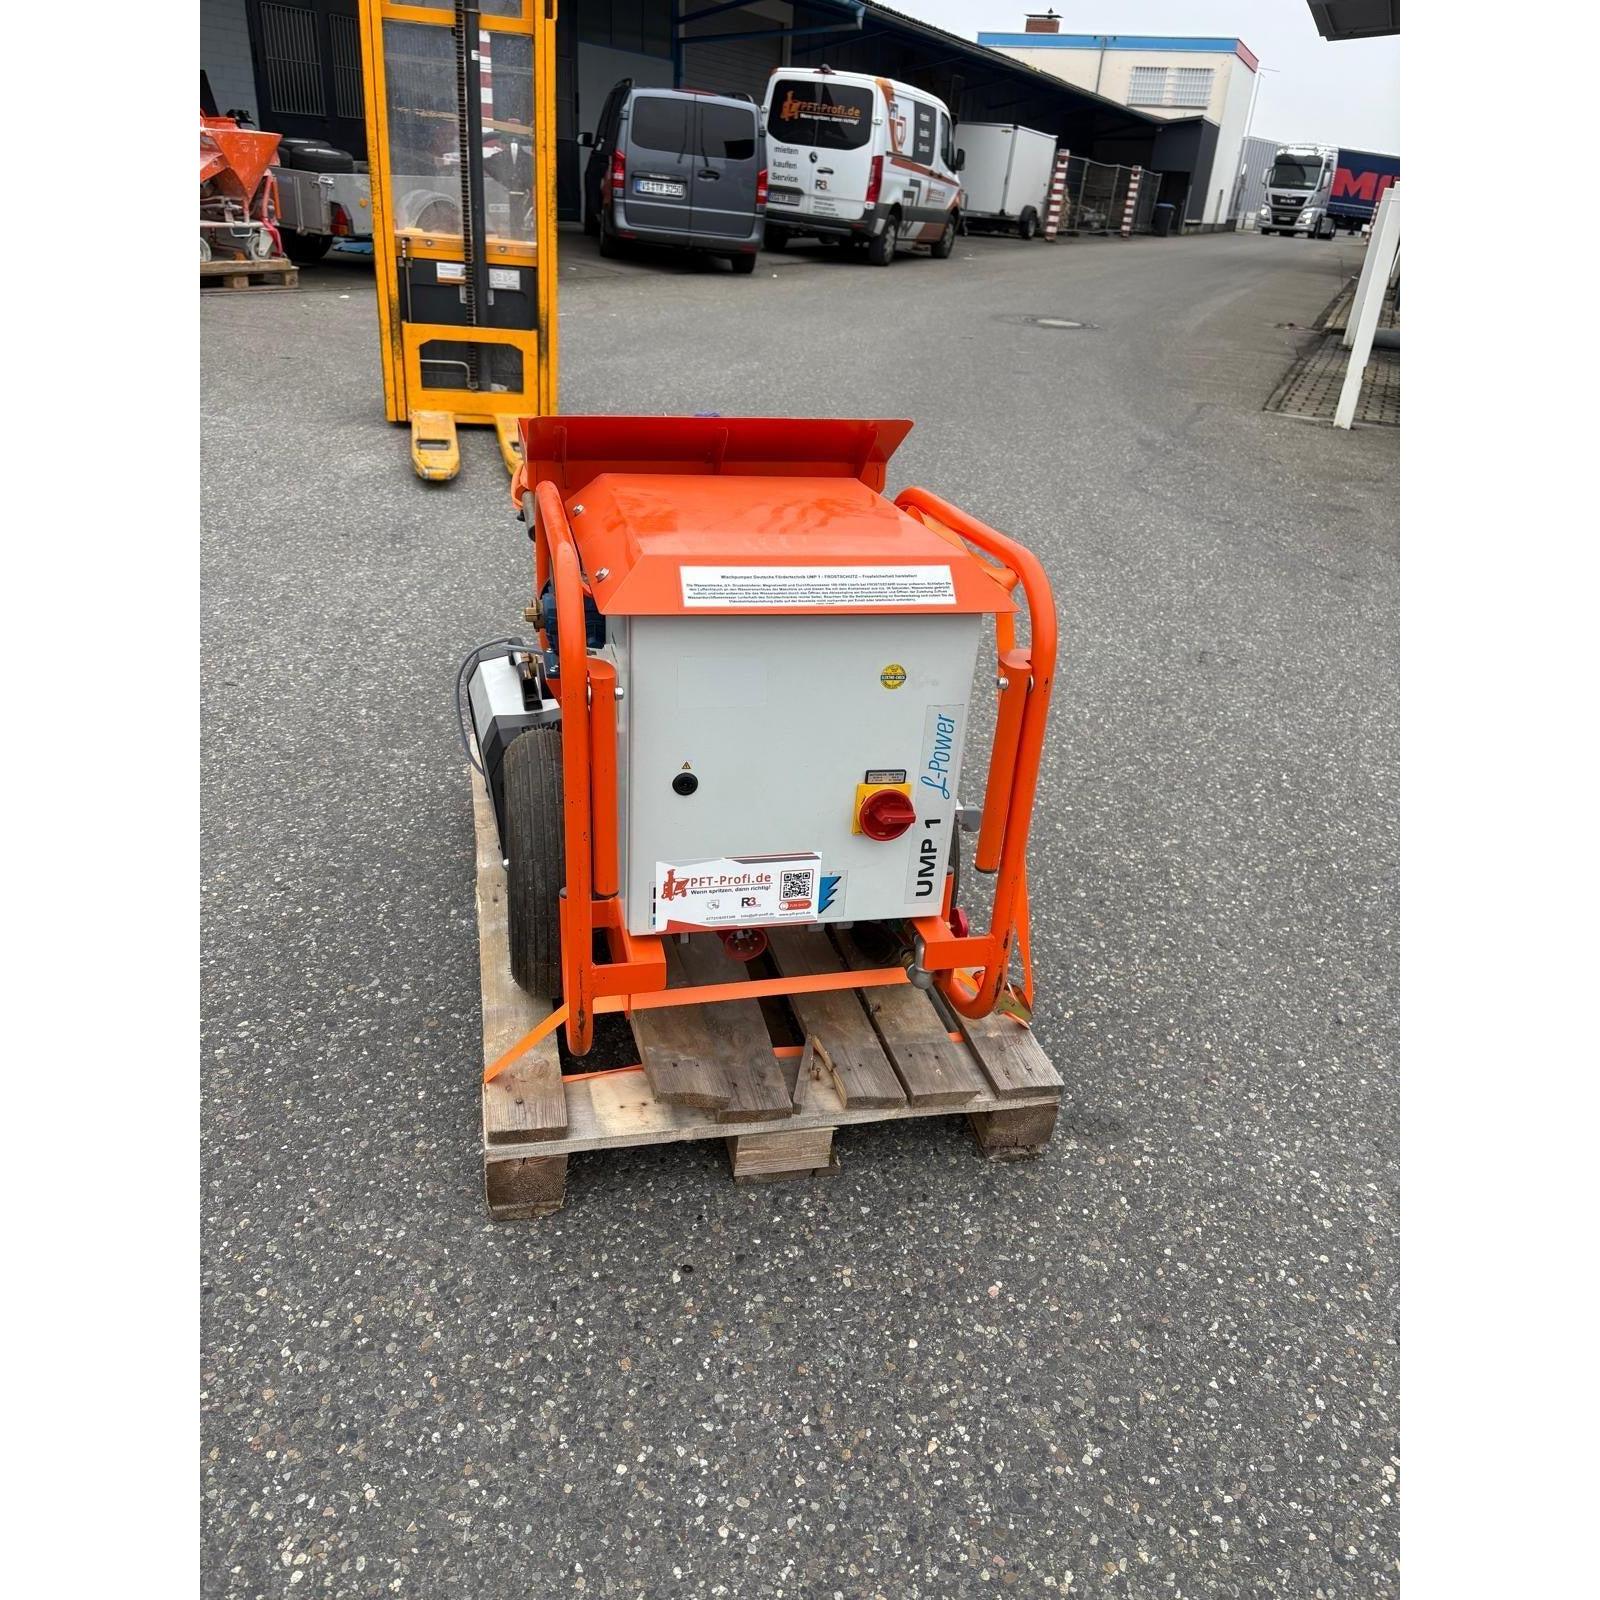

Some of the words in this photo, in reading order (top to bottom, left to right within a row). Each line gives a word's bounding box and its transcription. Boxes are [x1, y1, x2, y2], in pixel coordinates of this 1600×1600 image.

[800, 101, 860, 117] PFT-Profi.de
[774, 146, 799, 155] mieten
[773, 159, 798, 169] kaufen
[772, 172, 799, 182] Service
[920, 714, 955, 800] L-Power
[924, 818, 941, 829] 1
[916, 838, 937, 896] UMP
[690, 873, 772, 887] PFT-Profi.de
[741, 897, 756, 907] R3
